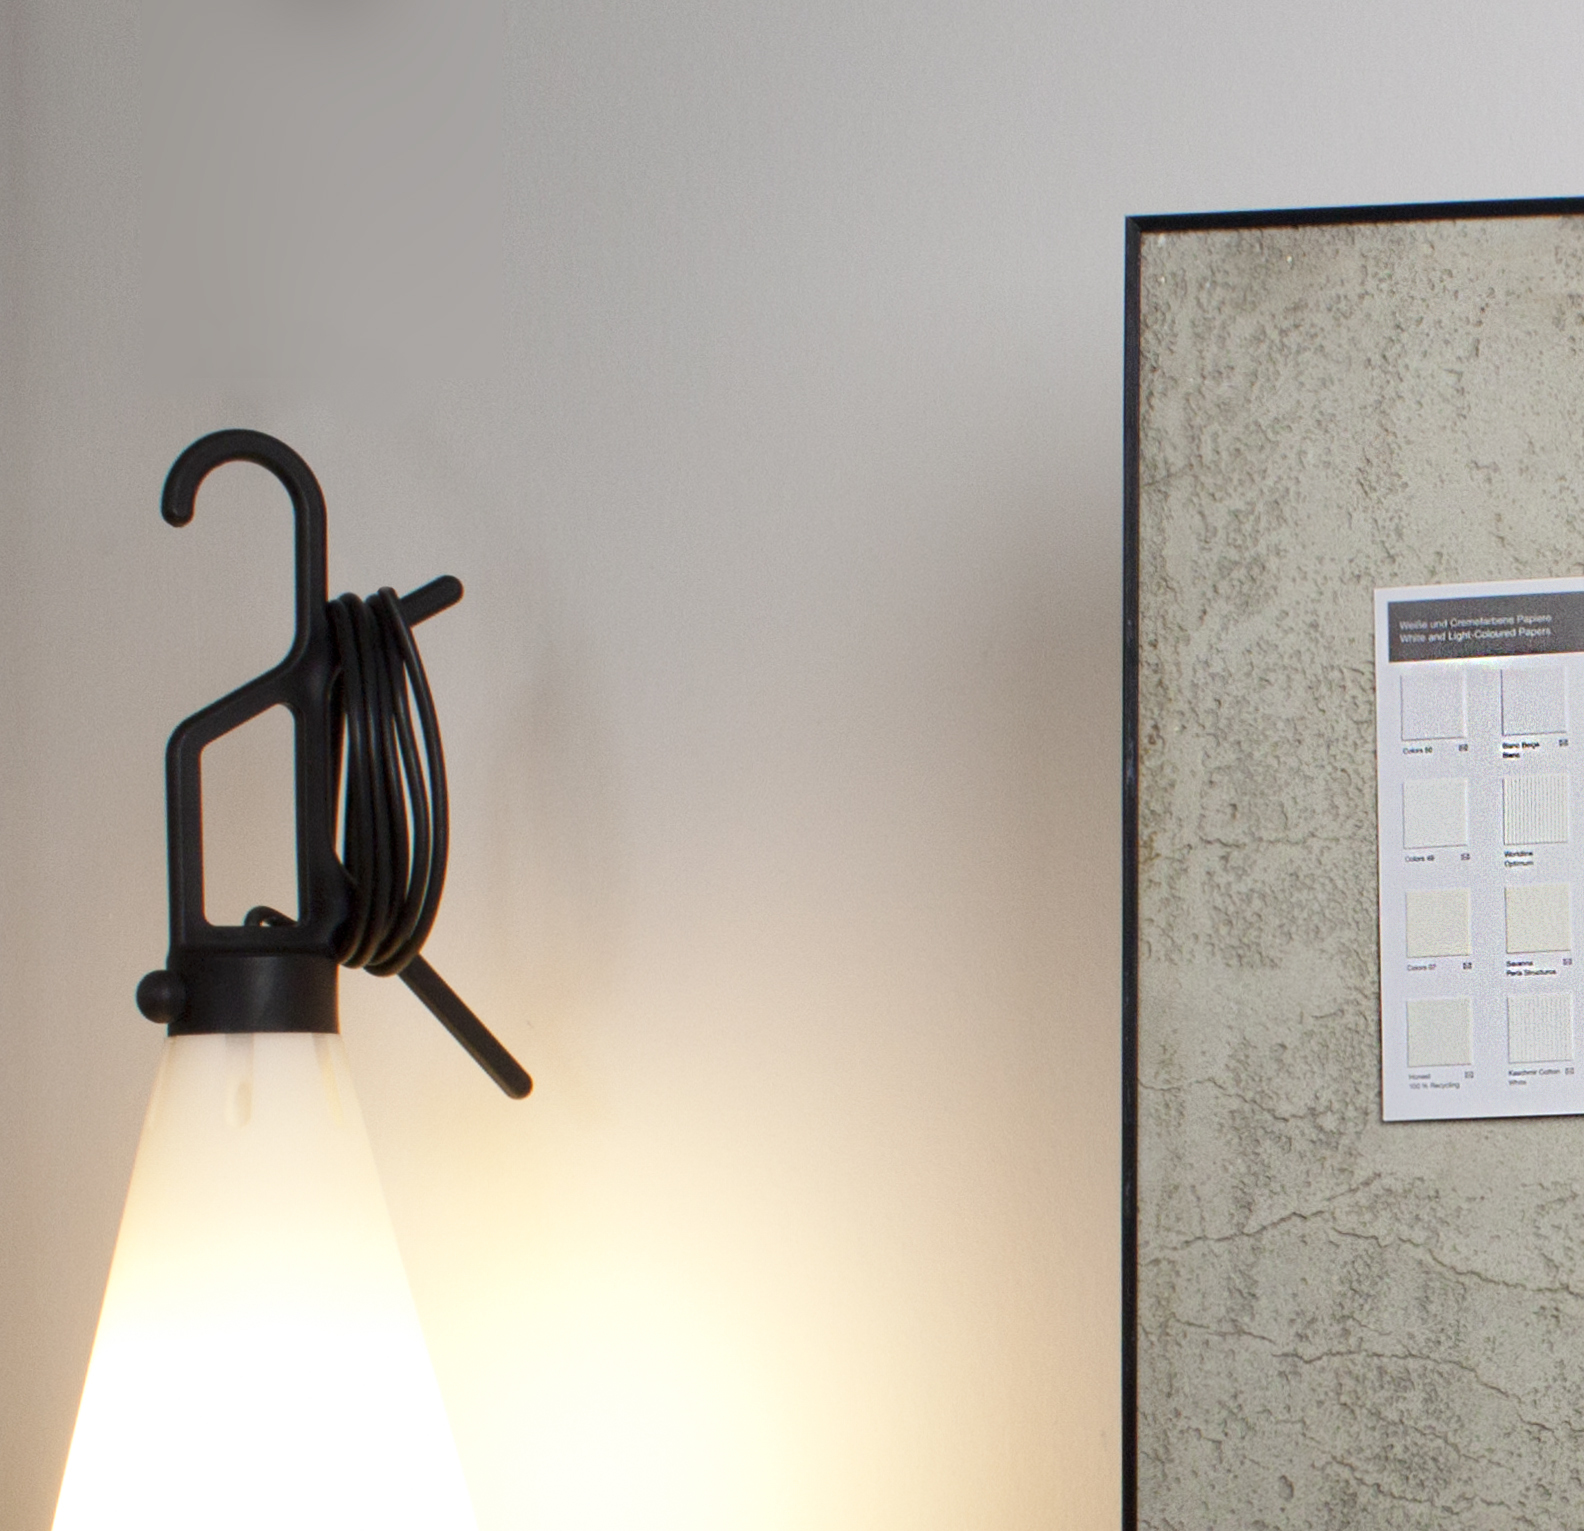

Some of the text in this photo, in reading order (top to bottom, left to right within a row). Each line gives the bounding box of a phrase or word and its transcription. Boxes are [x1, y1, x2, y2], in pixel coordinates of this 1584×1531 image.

[1400, 633, 1426, 643] White
[1428, 632, 1446, 642] and
[1518, 626, 1551, 638] Papers
[1402, 747, 1424, 755] Colors
